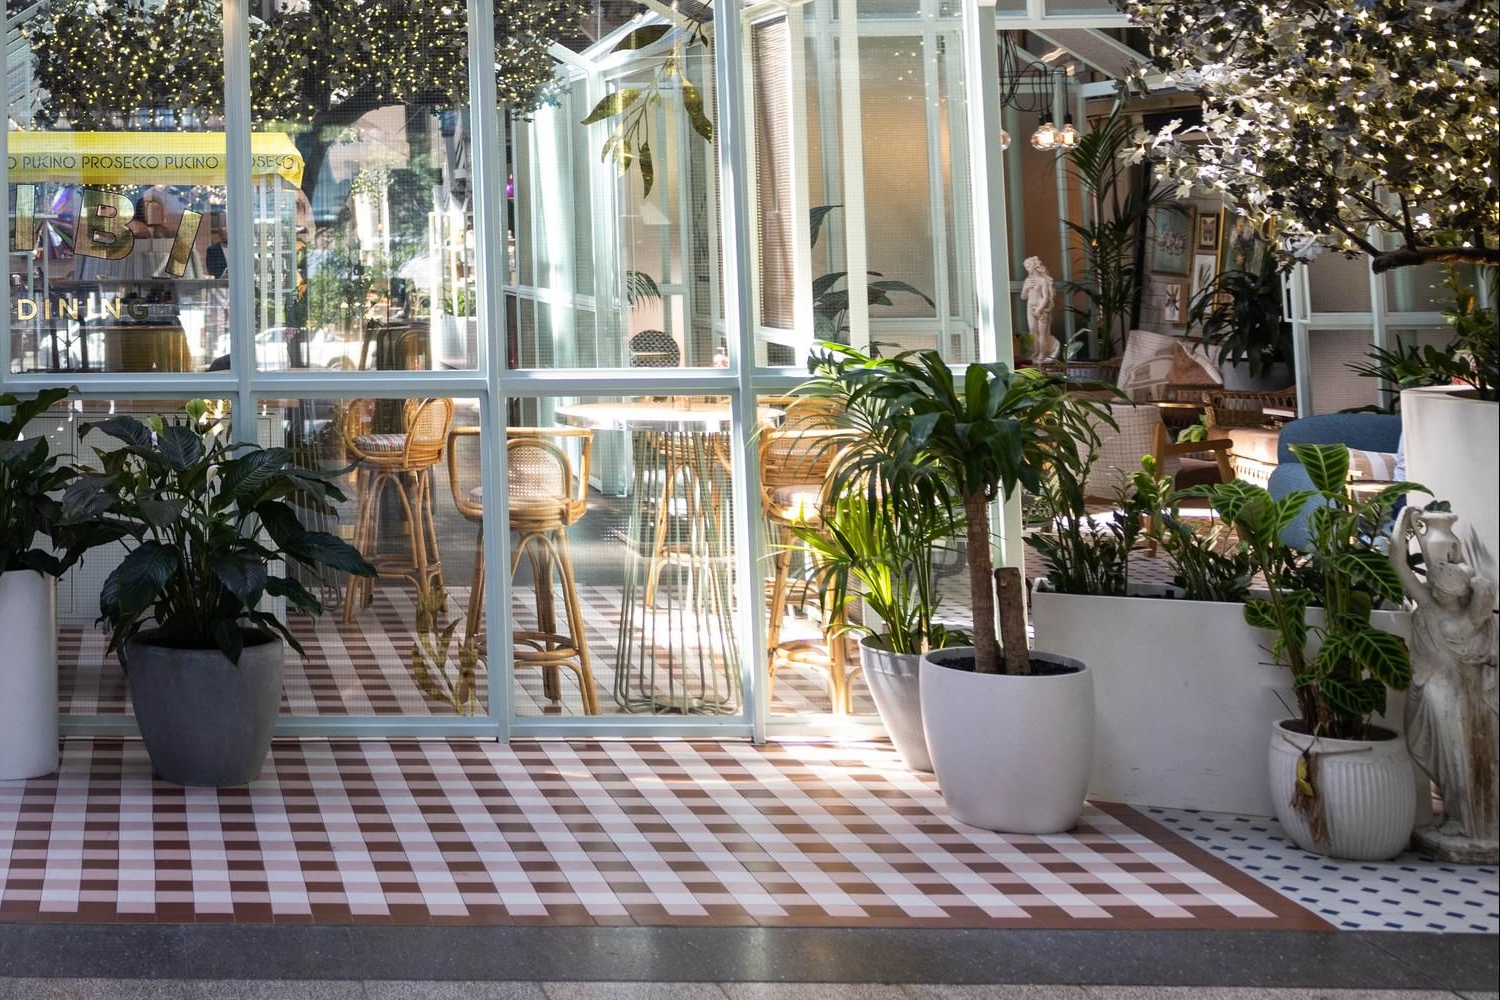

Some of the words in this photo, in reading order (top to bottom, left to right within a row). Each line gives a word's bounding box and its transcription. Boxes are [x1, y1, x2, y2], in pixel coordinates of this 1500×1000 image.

[23, 156, 76, 169] PUCINO
[82, 156, 159, 169] PROSECCO
[165, 156, 219, 169] PUCINO
[16, 298, 149, 320] DINING
